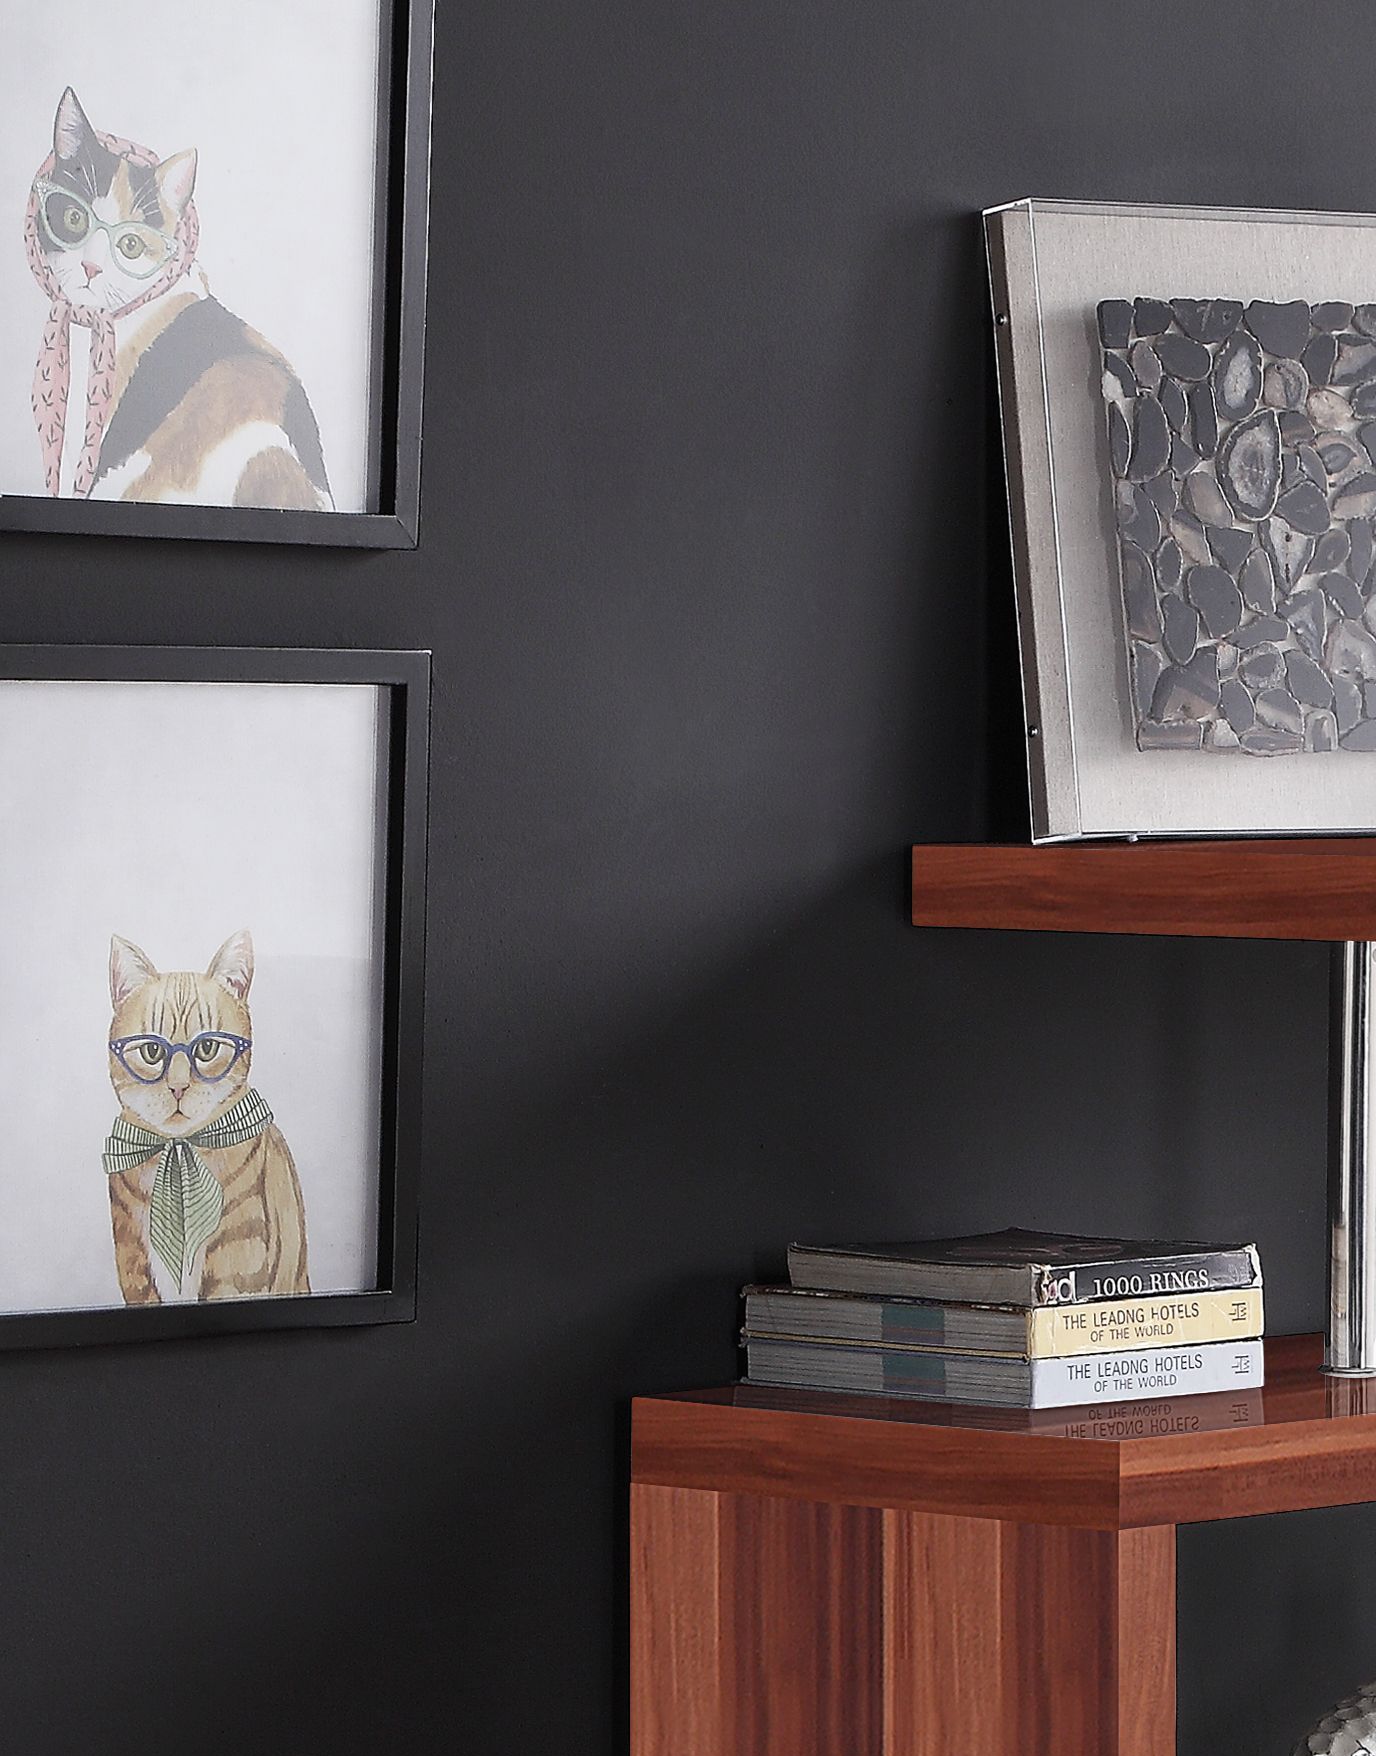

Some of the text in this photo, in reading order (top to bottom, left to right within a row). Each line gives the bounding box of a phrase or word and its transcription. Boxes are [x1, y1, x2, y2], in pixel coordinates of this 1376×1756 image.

[1094, 1277, 1143, 1297] 1000
[1149, 1269, 1209, 1291] RINGS
[1063, 1314, 1087, 1331] THE
[1151, 1302, 1200, 1322] HOTELS
[1090, 1323, 1174, 1343] OF THE WORLD
[1067, 1363, 1091, 1381] THE
[1155, 1354, 1203, 1372] HOTELS
[1094, 1374, 1177, 1393] OF THE WORLD
